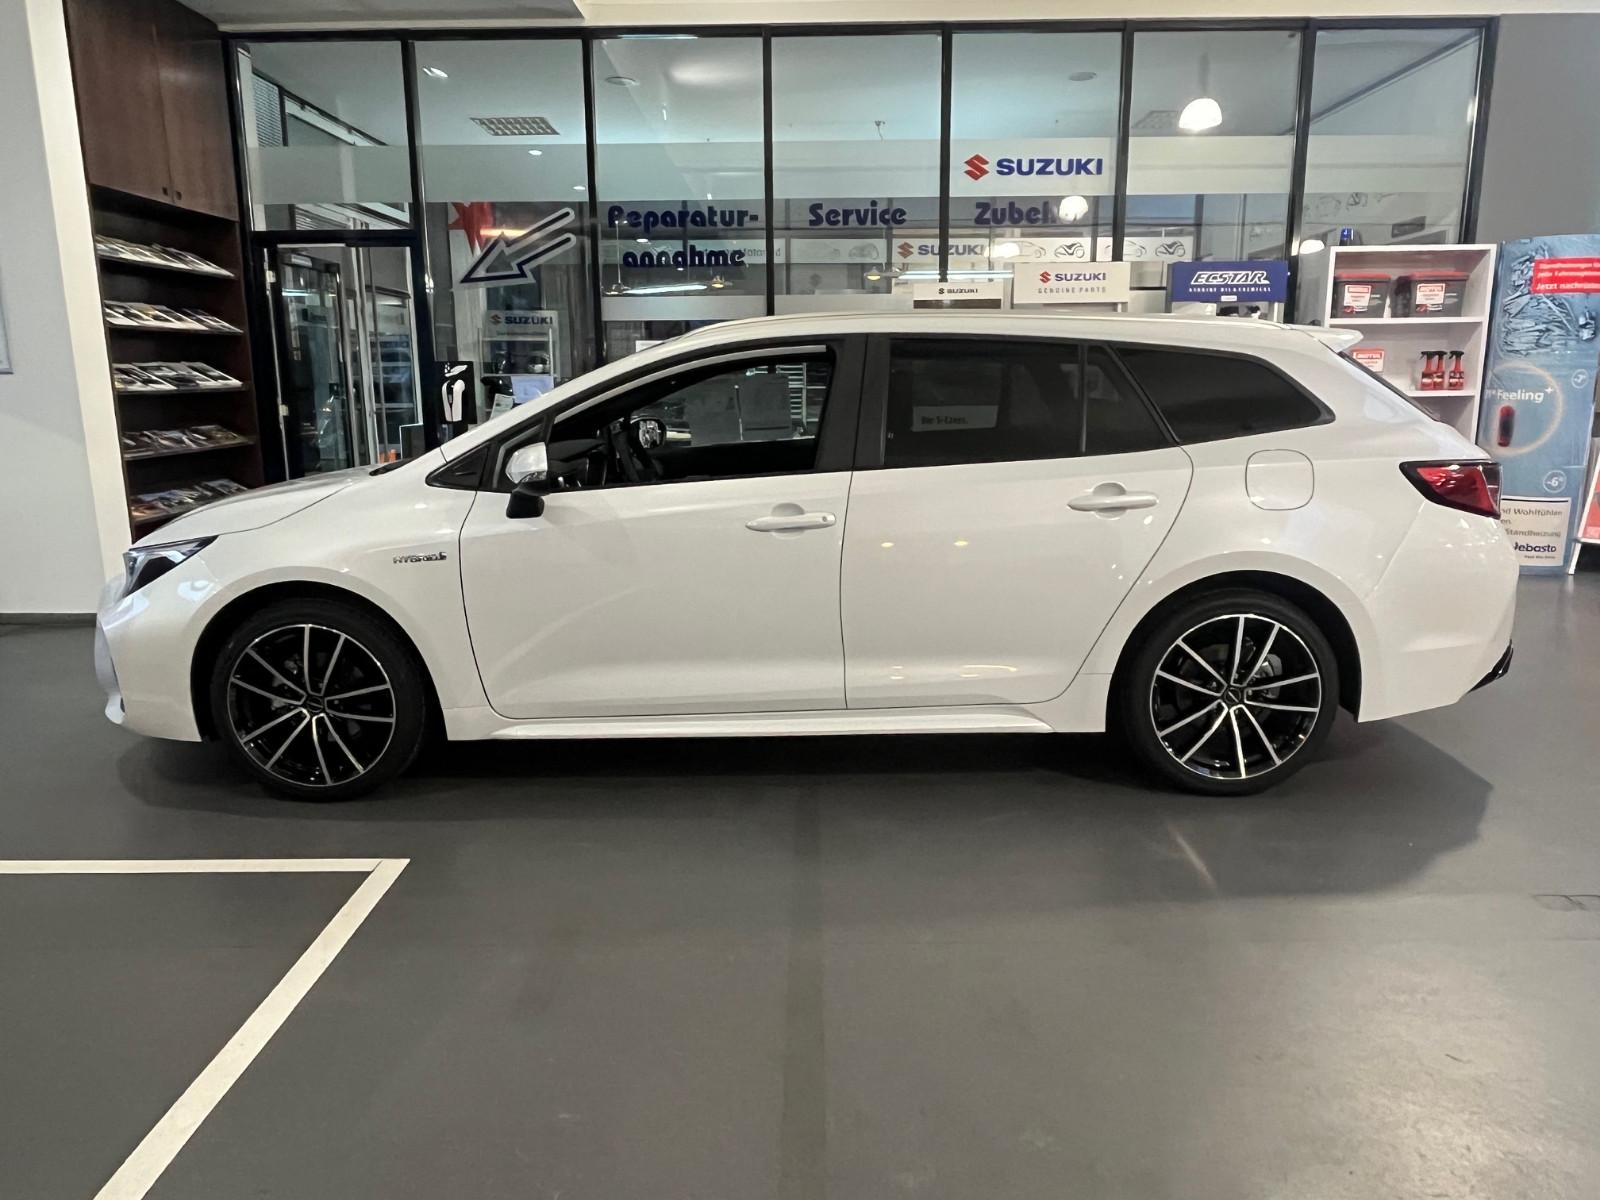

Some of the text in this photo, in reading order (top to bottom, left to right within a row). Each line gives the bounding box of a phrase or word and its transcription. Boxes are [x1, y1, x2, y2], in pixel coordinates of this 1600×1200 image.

[996, 157, 1104, 176] SUZUKI
[608, 205, 759, 233] Reparatur-
[809, 200, 907, 226] Service
[622, 245, 746, 267] annahme
[1055, 272, 1107, 281] SUZUKI
[1190, 271, 1271, 285] ECSTAR
[504, 316, 553, 325] SUZUKI
